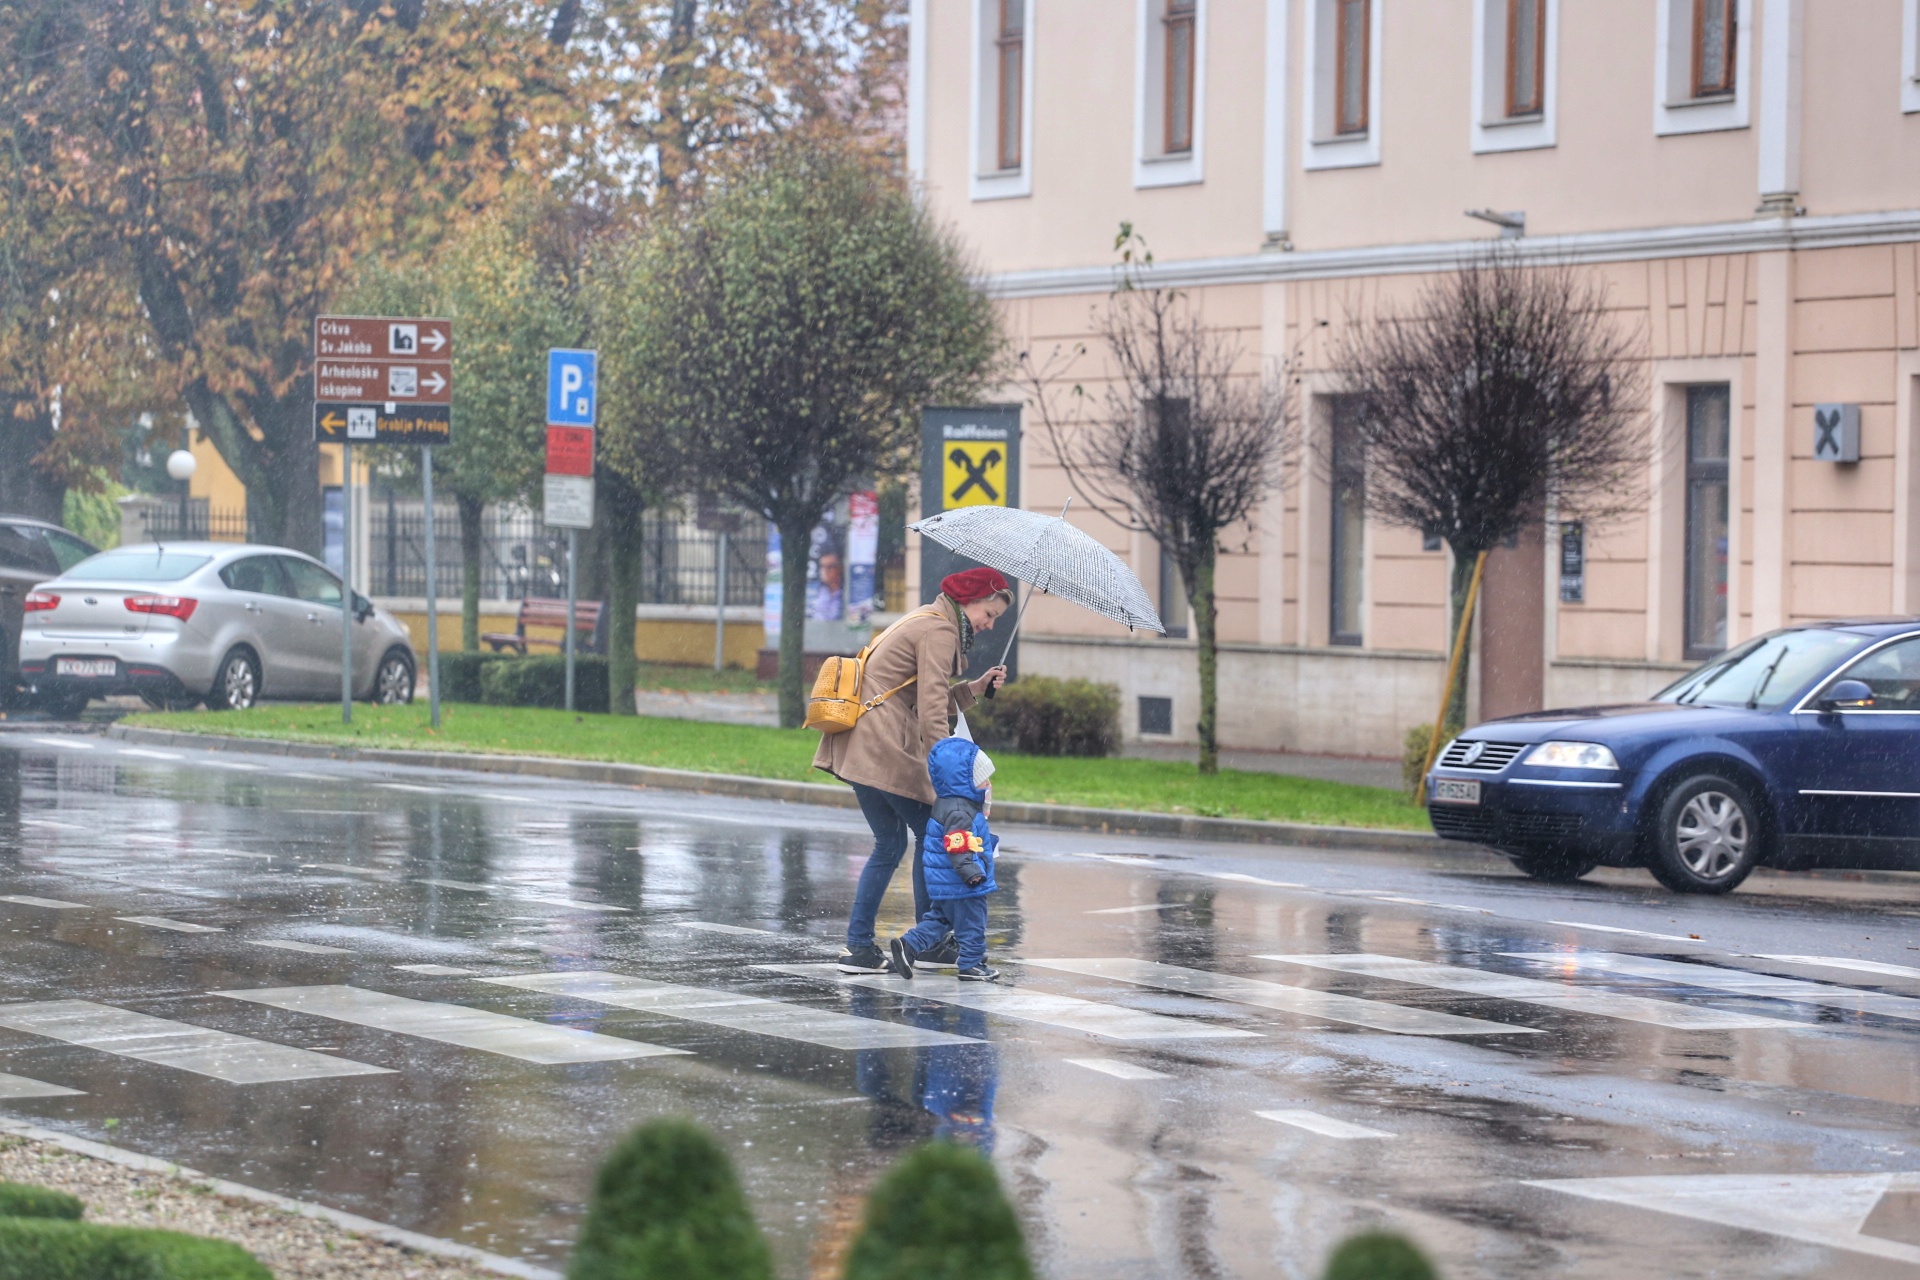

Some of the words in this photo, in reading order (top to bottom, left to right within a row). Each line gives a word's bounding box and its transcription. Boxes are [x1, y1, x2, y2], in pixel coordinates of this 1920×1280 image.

[321, 322, 350, 335] Crkva
[320, 364, 379, 379] Arheološke
[320, 384, 363, 399] iskopine
[561, 364, 582, 410] P
[378, 418, 413, 434] Groblje
[417, 418, 449, 435] Prelog
[943, 424, 1008, 439] Raiffeisen
